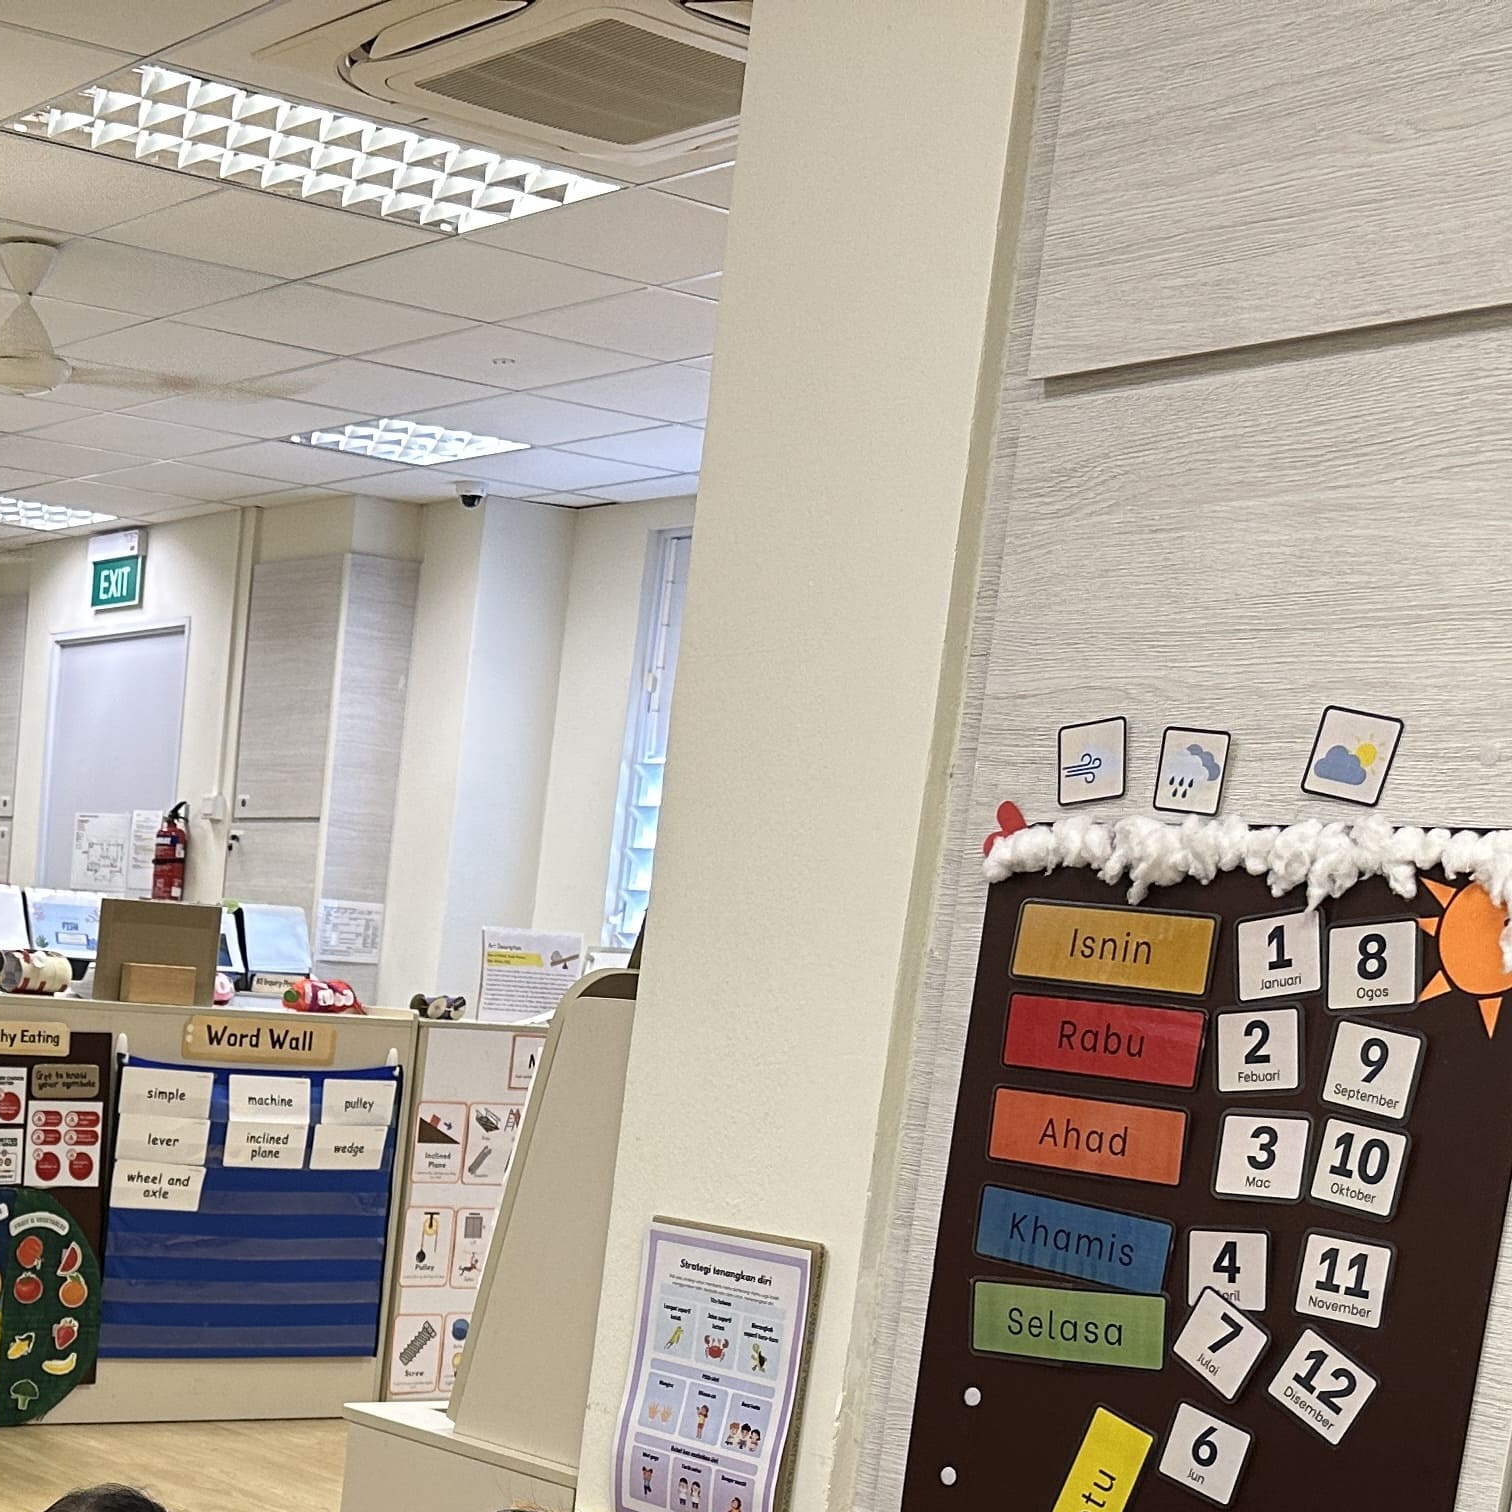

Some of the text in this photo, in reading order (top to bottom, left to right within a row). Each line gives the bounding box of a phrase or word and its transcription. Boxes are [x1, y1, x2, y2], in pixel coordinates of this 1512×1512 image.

[99, 566, 131, 600] EXIT
[1069, 927, 1153, 965] Isnin
[1267, 924, 1293, 971] 1
[1357, 933, 1387, 980] 8
[1260, 973, 1302, 990] Januari
[1356, 986, 1389, 1001] Ogos
[20, 1029, 60, 1047] Eating
[206, 1024, 314, 1051] Word Wall
[1057, 1019, 1145, 1058] Rabu
[1243, 1019, 1271, 1065] 2
[1360, 1037, 1389, 1084] 9
[1238, 1069, 1281, 1083] Febuari
[146, 1088, 186, 1102] simple
[247, 1094, 293, 1108] machine
[344, 1098, 375, 1112] pulley
[1333, 1083, 1399, 1110] September
[147, 1134, 179, 1147] lever
[246, 1132, 289, 1146] inclined
[334, 1143, 365, 1155] wedge
[1038, 1117, 1129, 1157] Ahad
[1246, 1125, 1278, 1171] 3
[250, 1146, 280, 1161] plane
[425, 1152, 451, 1160] Inclined
[428, 1161, 447, 1169] Plane
[1328, 1131, 1390, 1185] 10
[126, 1172, 190, 1187] wheel and
[1245, 1175, 1271, 1189] Mac
[143, 1187, 169, 1199] axle
[1330, 1182, 1377, 1204] Oktober
[1009, 1212, 1135, 1267] Khamis
[415, 1263, 435, 1272] Pulley
[680, 1258, 712, 1276] Strategi
[757, 1274, 773, 1287] diri
[1212, 1240, 1241, 1284] 4
[1315, 1247, 1370, 1300] 11
[1308, 1295, 1372, 1319] November
[1007, 1307, 1123, 1347] Selasa
[1207, 1311, 1244, 1354] 7
[404, 1369, 424, 1377] Screw
[1196, 1353, 1221, 1377] Julai
[1292, 1349, 1357, 1416] 12
[1283, 1385, 1335, 1431] Disember
[1191, 1425, 1218, 1468] 6
[1187, 1468, 1205, 1485] Jun
